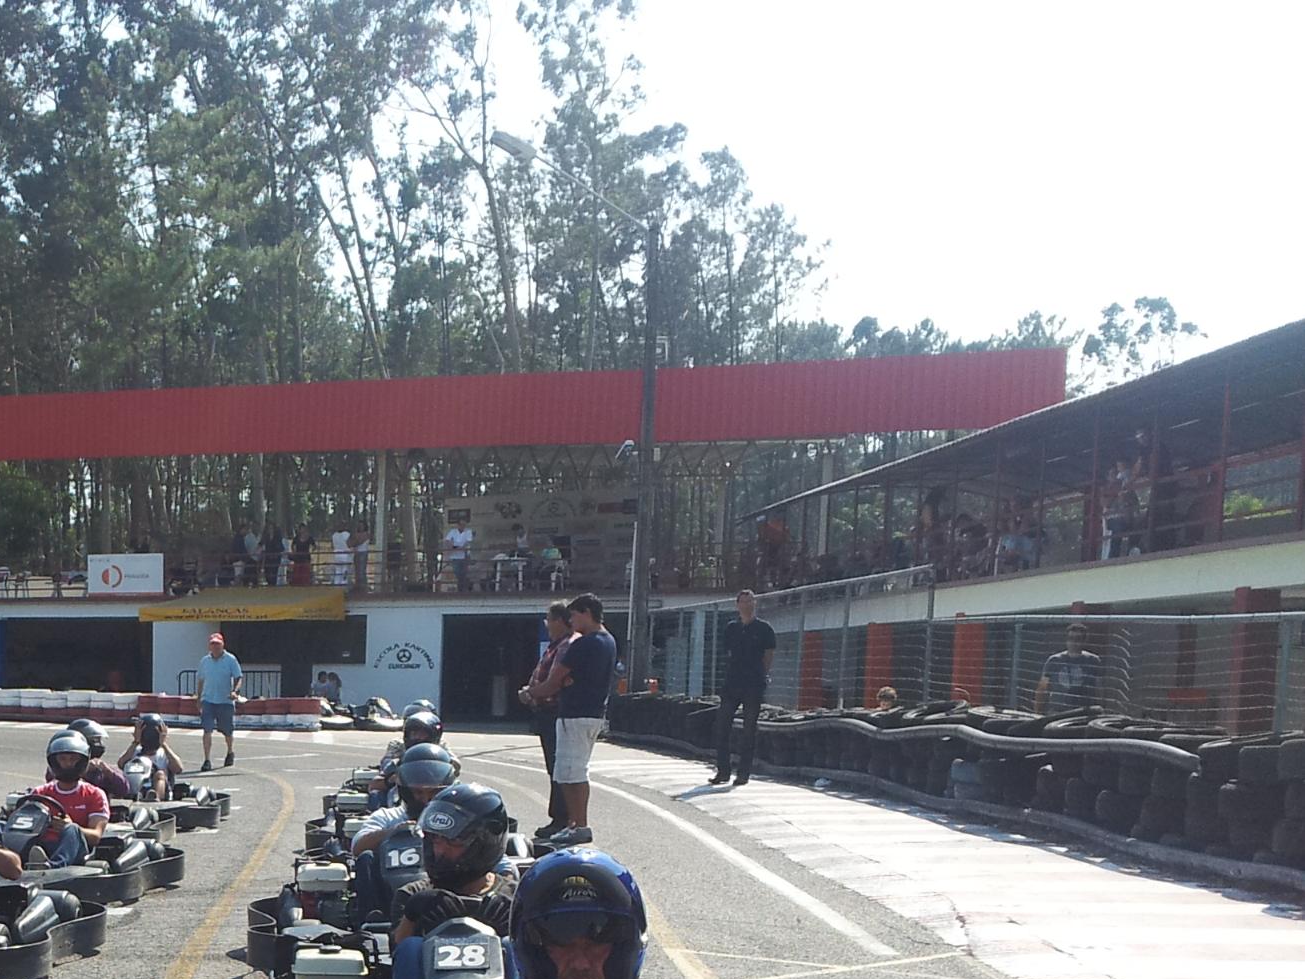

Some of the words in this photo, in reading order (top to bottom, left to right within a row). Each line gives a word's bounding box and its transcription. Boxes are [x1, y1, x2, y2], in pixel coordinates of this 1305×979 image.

[373, 643, 400, 669] ESCOLA
[405, 642, 435, 670] KARTING
[12, 816, 34, 829] 5
[388, 848, 420, 867] 16
[437, 944, 486, 967] 28
